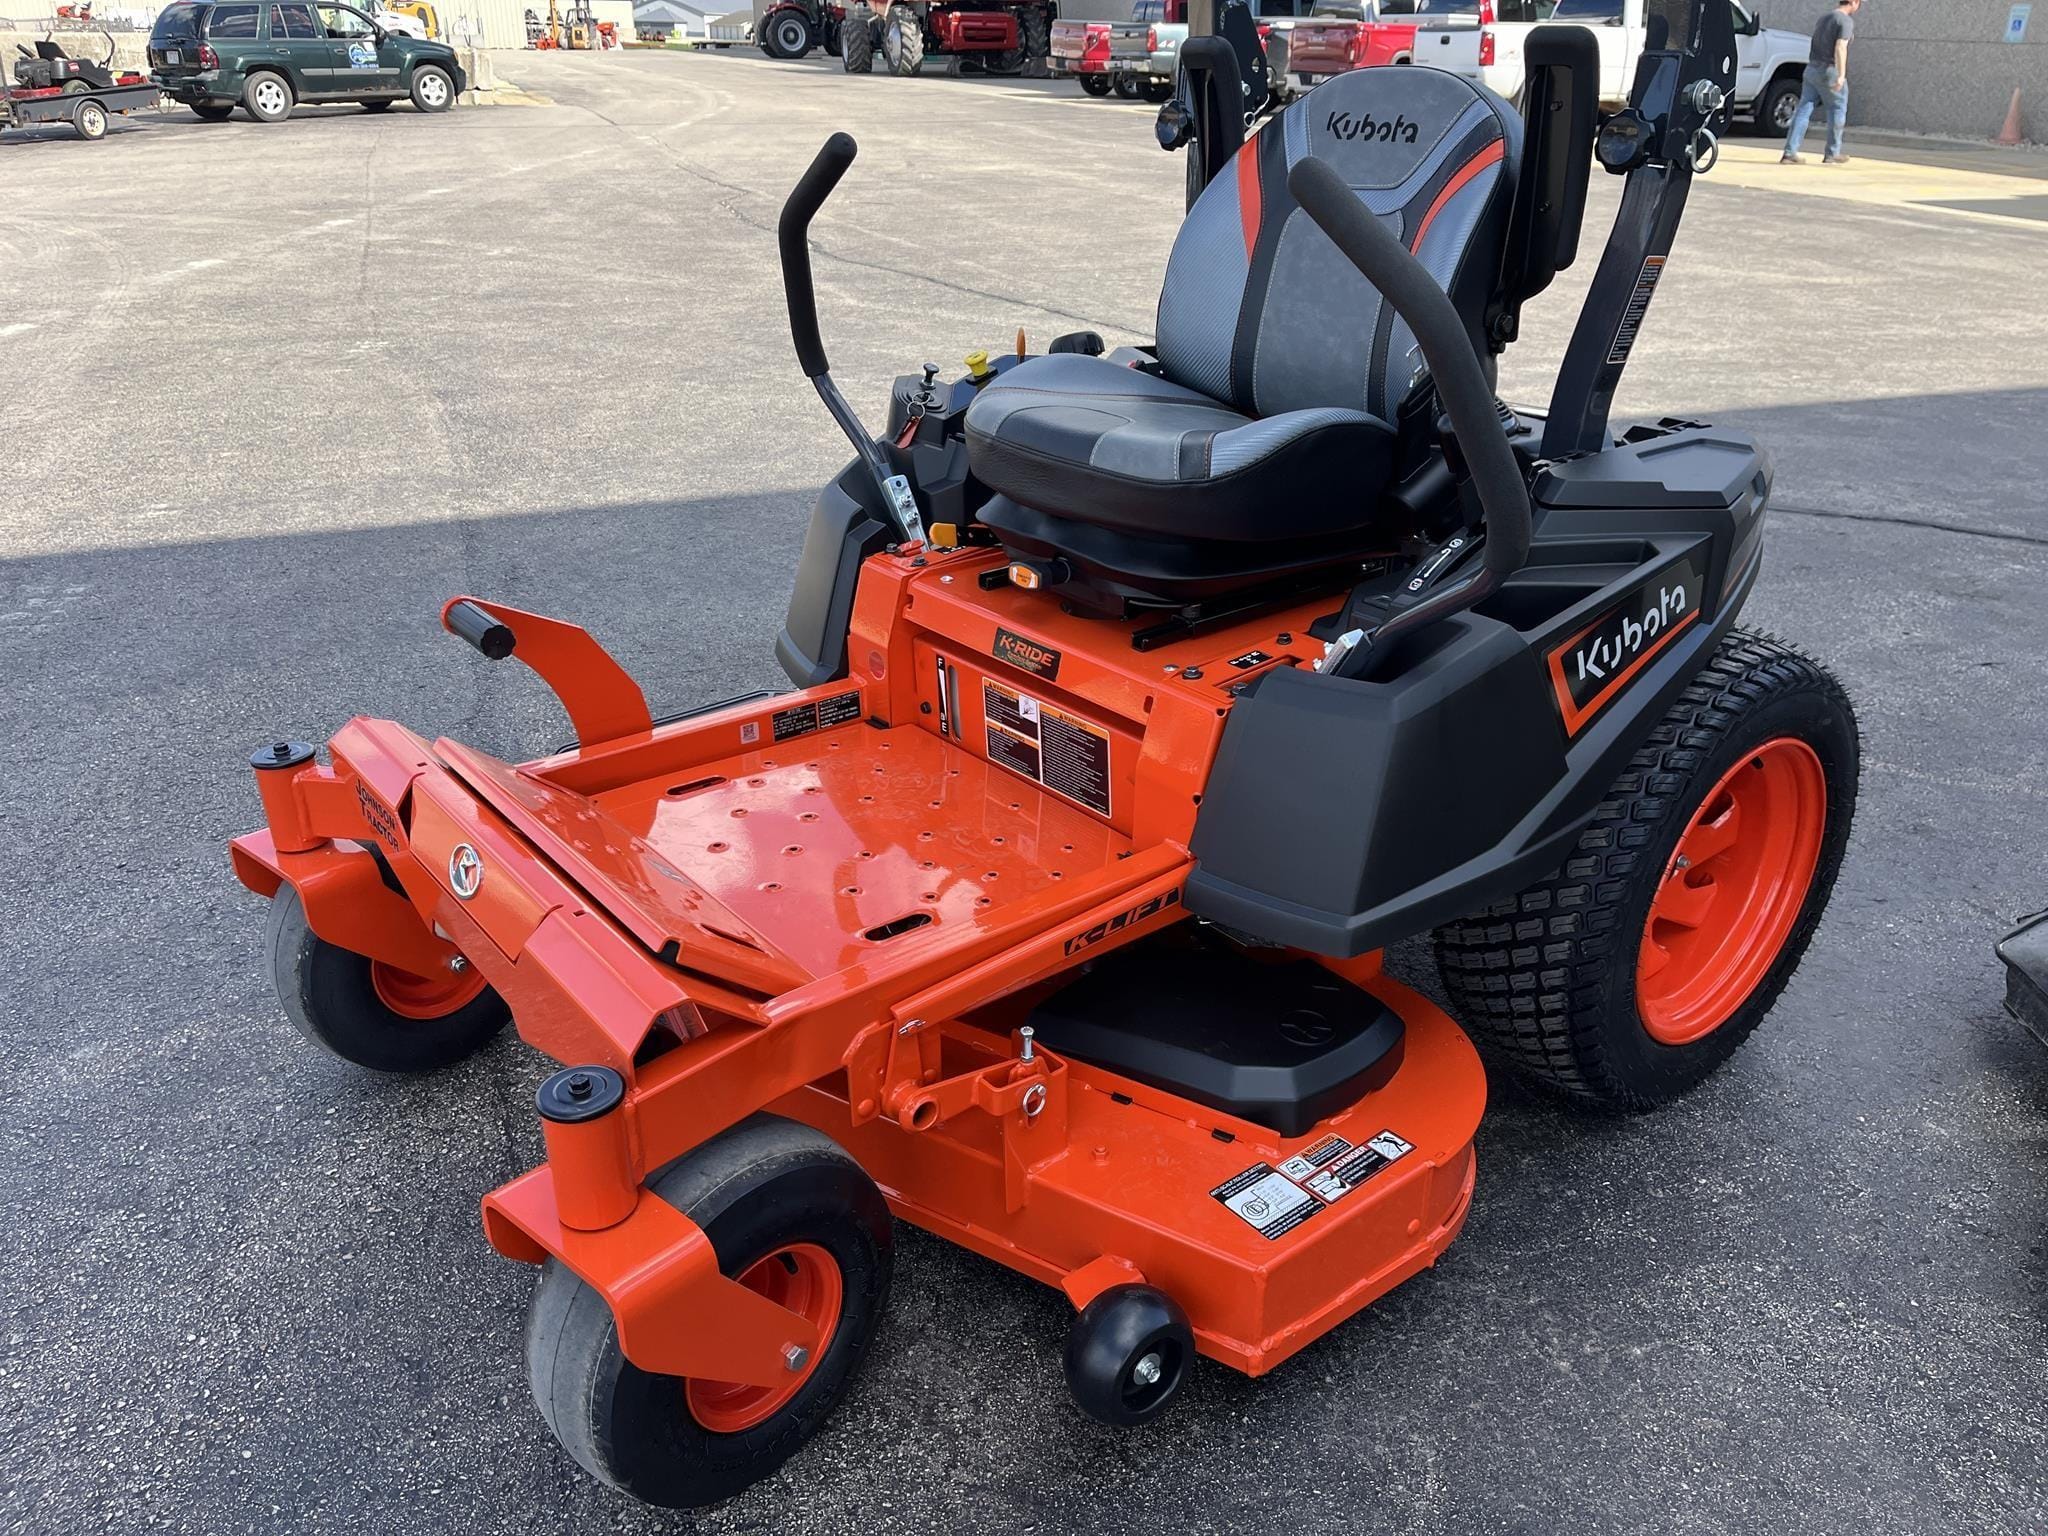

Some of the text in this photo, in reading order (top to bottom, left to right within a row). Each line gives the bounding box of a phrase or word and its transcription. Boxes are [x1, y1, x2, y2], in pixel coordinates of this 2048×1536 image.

[1326, 111, 1419, 144] Kubota
[1576, 584, 1686, 681] Kubota
[356, 778, 396, 831] JOHNSON
[359, 796, 400, 853] TRACTOR
[1068, 889, 1177, 955] K-LIFT
[1305, 1135, 1335, 1155] WARNING
[1336, 1145, 1368, 1167] DANGER
